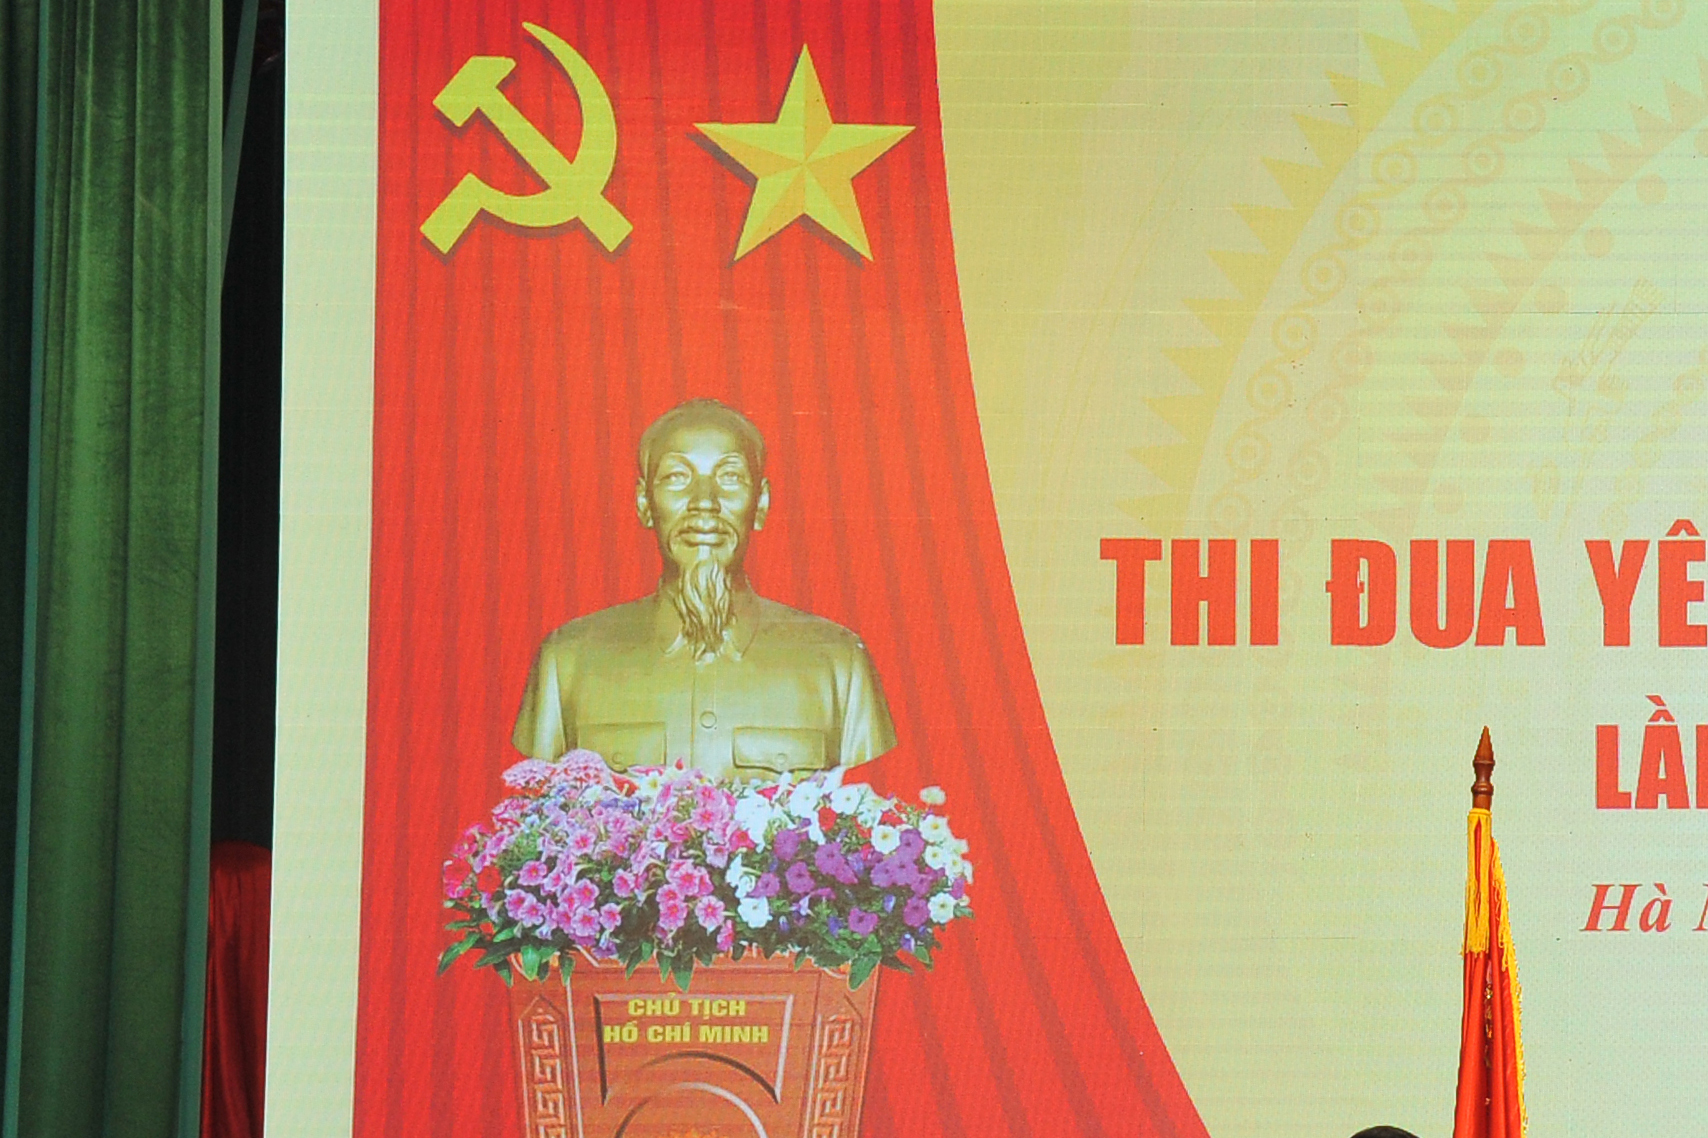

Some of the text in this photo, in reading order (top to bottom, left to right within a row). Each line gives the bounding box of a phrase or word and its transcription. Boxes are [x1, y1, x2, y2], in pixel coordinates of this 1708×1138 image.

[1100, 537, 1280, 647] THI
[1325, 538, 1547, 649] ĐUA
[1580, 883, 1672, 933] Hà
[627, 992, 747, 1020] CHỦ TỊCH
[603, 1020, 769, 1044] HỒ CHÍ MINH
